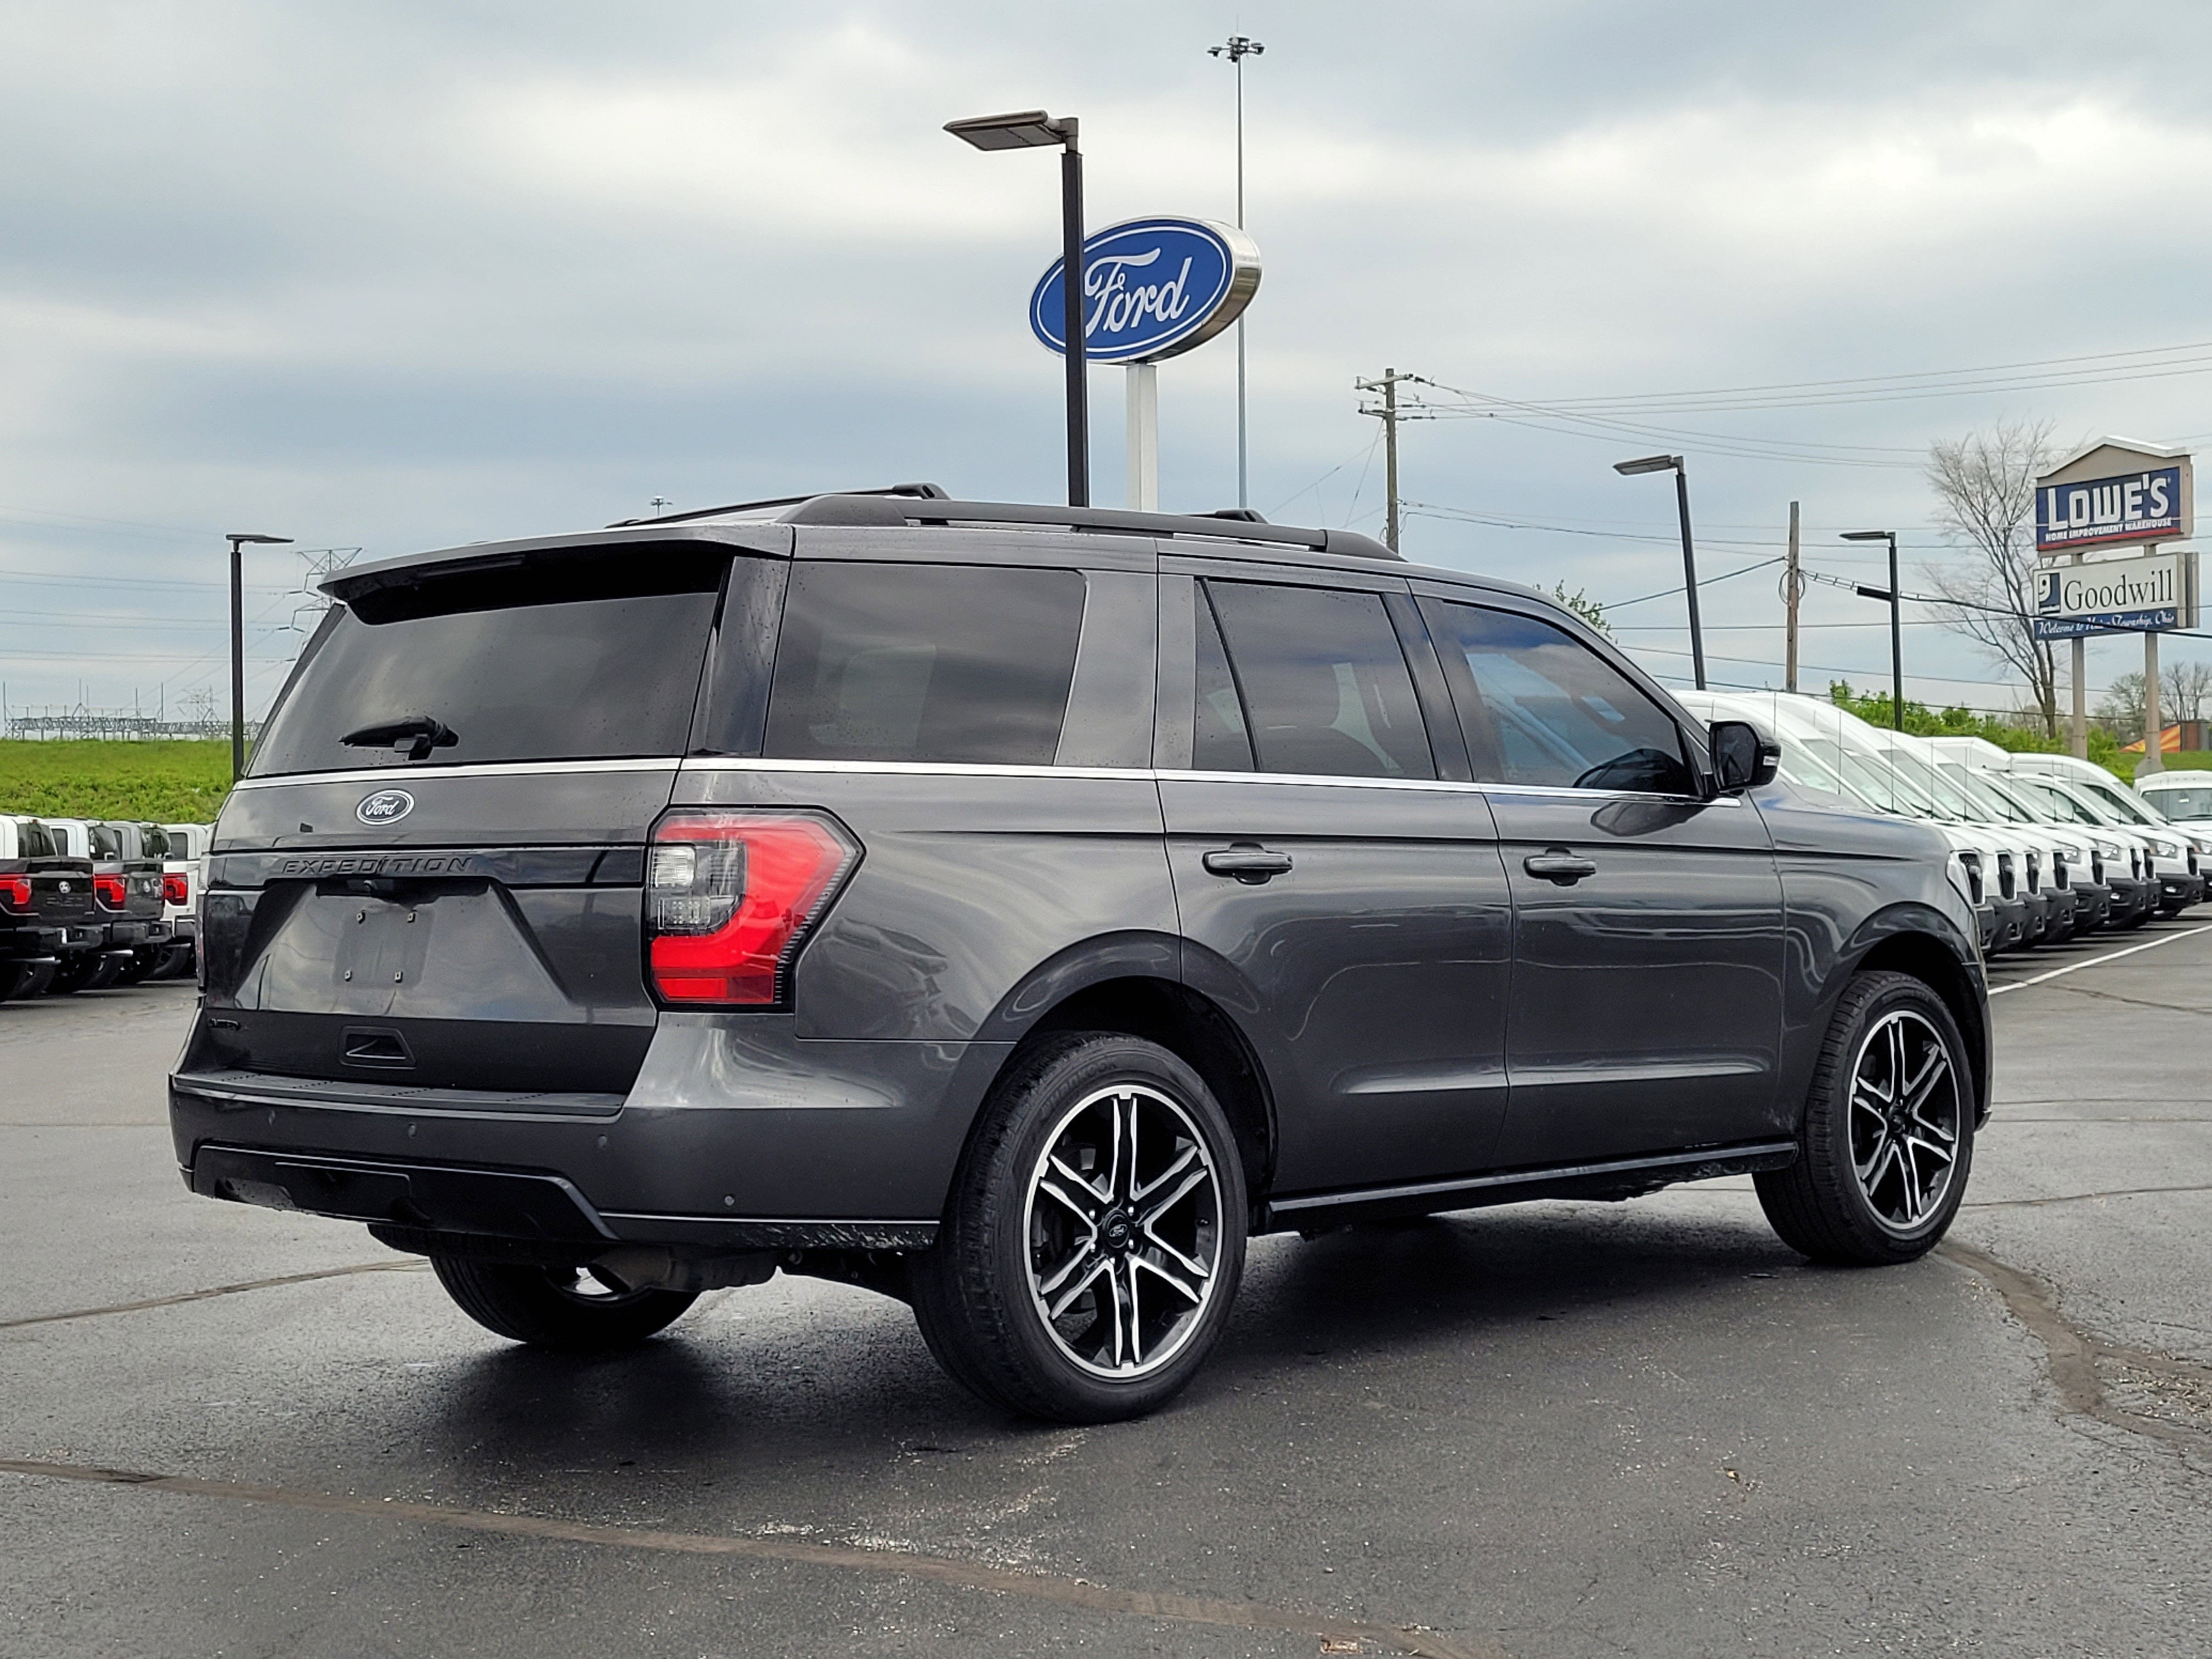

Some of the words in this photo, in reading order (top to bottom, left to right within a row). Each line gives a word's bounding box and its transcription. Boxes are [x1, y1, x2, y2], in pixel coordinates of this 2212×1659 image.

[1084, 247, 1193, 338] Ford
[2047, 473, 2169, 531] LOWE'S
[2045, 531, 2068, 542] HOME
[2069, 523, 2124, 539] IMPROVEMENT
[2125, 517, 2171, 532] WAREHOUSE
[2064, 568, 2173, 611] Goodwill
[2039, 621, 2074, 635] Welcome
[365, 795, 400, 816] Ford
[281, 856, 473, 875] EXPEDITION
